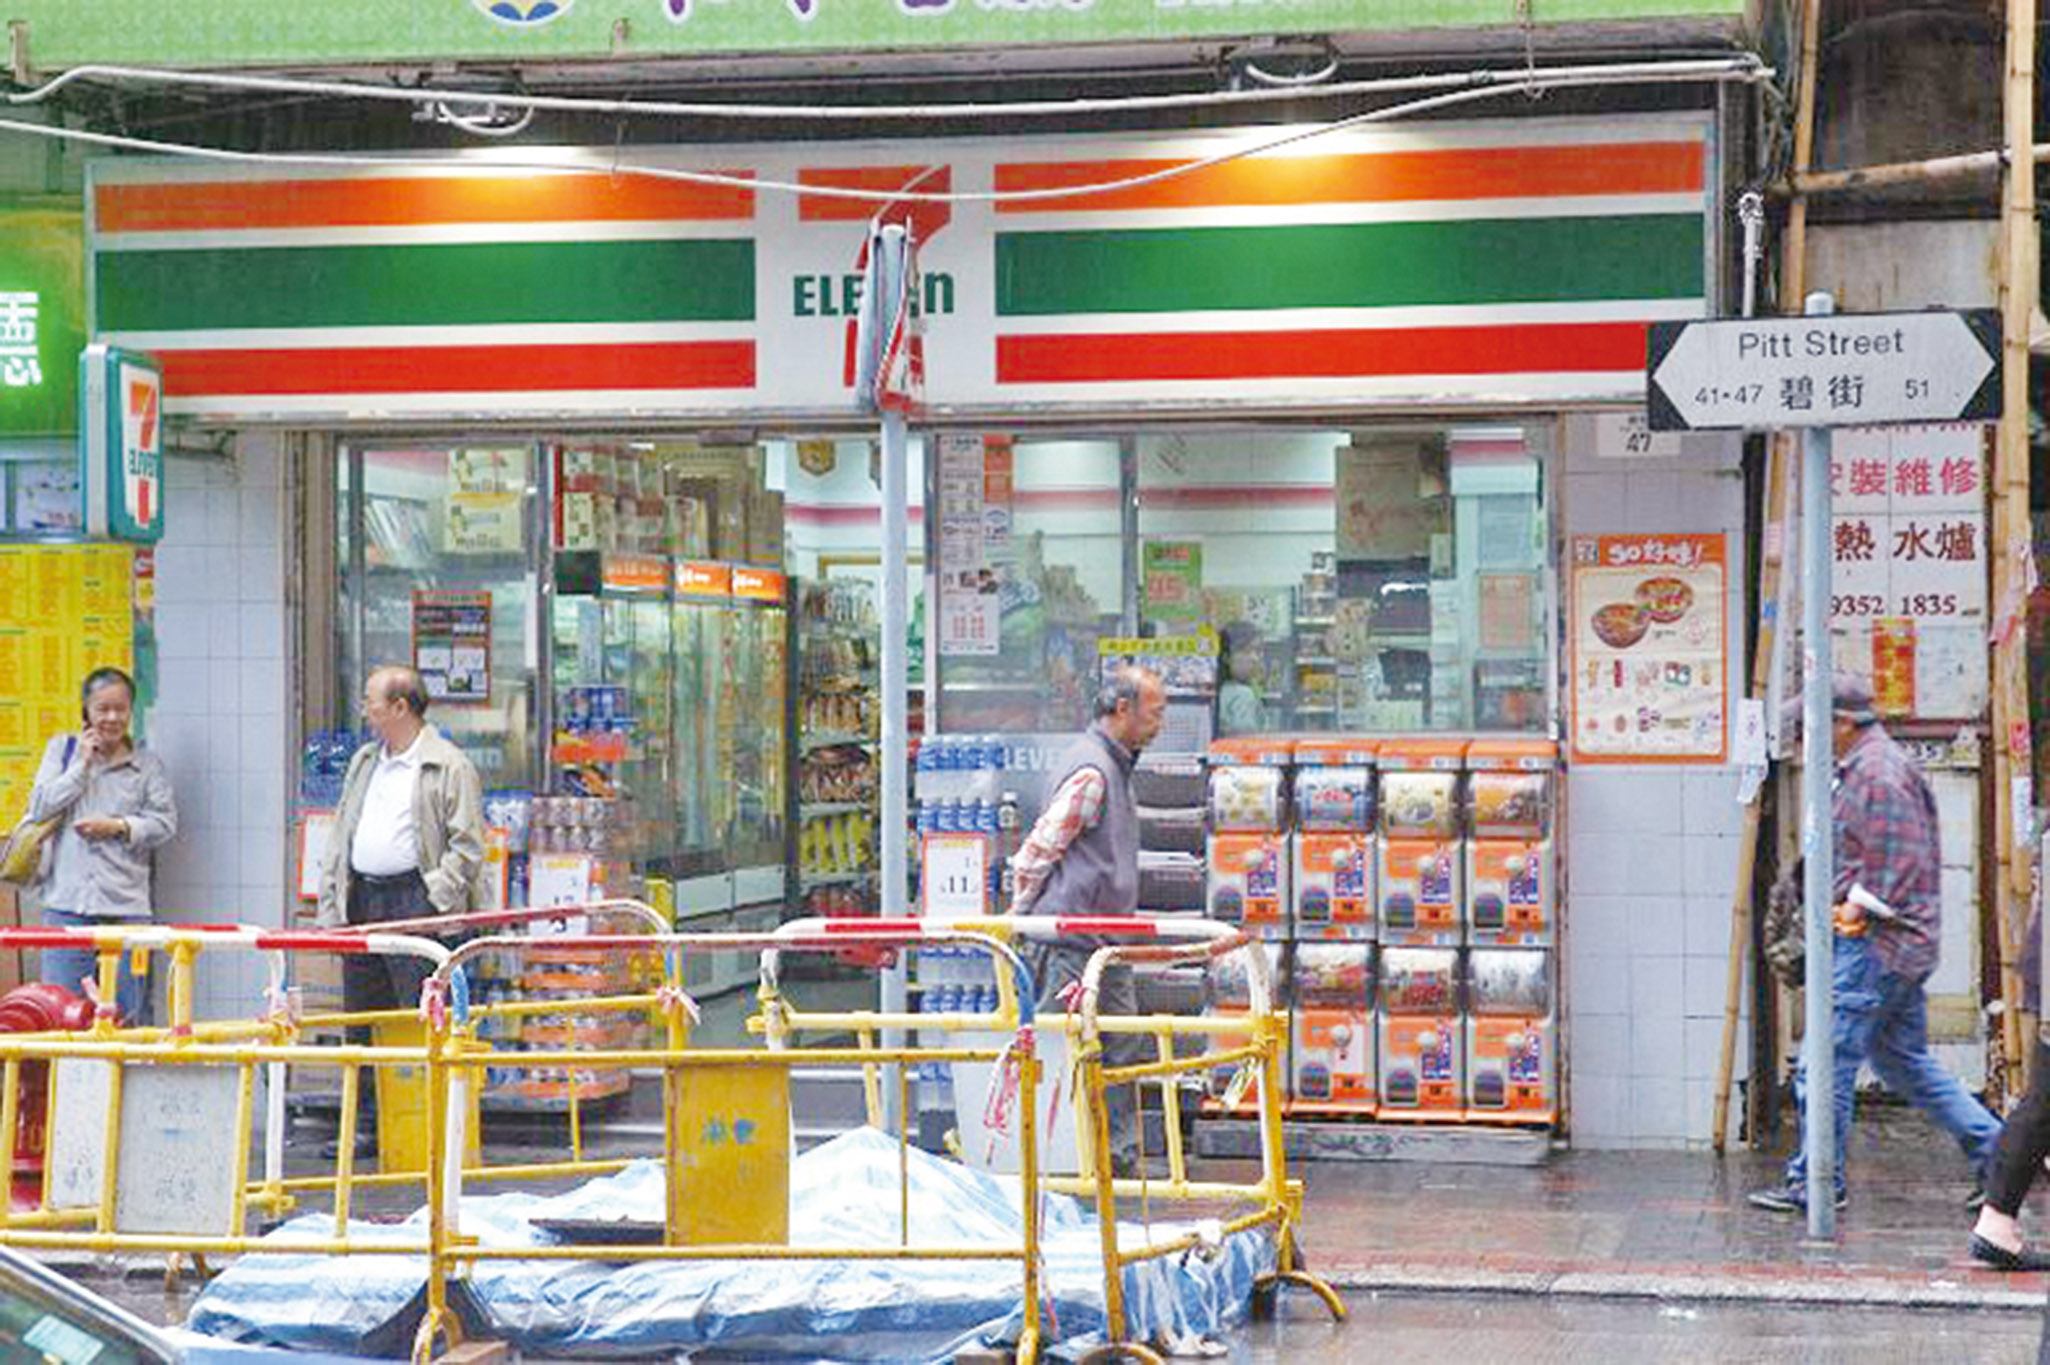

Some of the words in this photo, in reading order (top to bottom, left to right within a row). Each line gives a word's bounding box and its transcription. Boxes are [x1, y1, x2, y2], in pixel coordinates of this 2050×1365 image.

[793, 268, 954, 317] ELEn
[1738, 332, 1792, 359] Pitt
[1804, 328, 1904, 356] Street
[1779, 375, 1865, 410] 碧街
[1904, 378, 1930, 400] 51
[1625, 432, 1652, 453] 47
[1901, 594, 1958, 616] 1835
